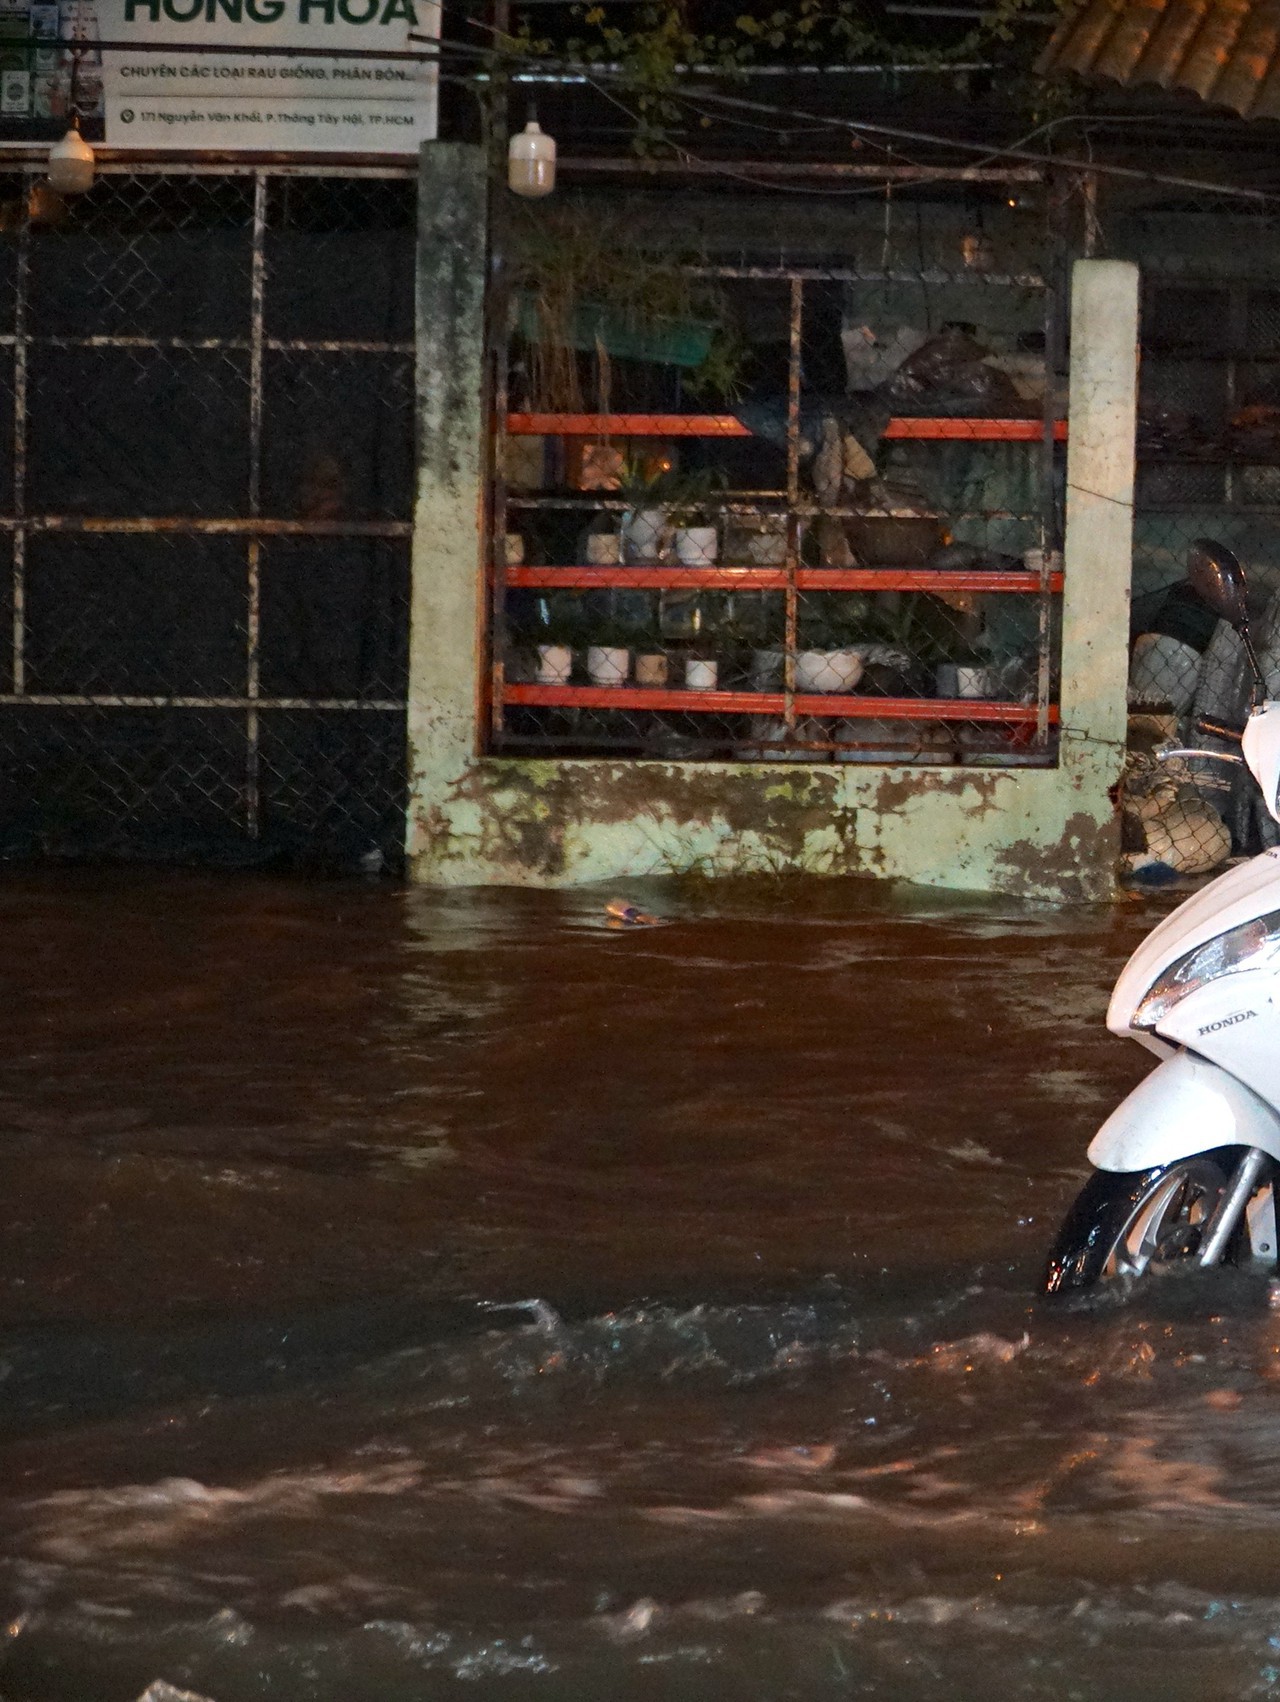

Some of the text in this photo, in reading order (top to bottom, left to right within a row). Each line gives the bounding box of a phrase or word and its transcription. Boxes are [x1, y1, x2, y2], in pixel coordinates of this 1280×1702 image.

[120, 64, 177, 78] CHUYÊN
[247, 68, 277, 79] RAU
[332, 67, 372, 80] PHÂN
[1198, 1010, 1258, 1037] HONDA
